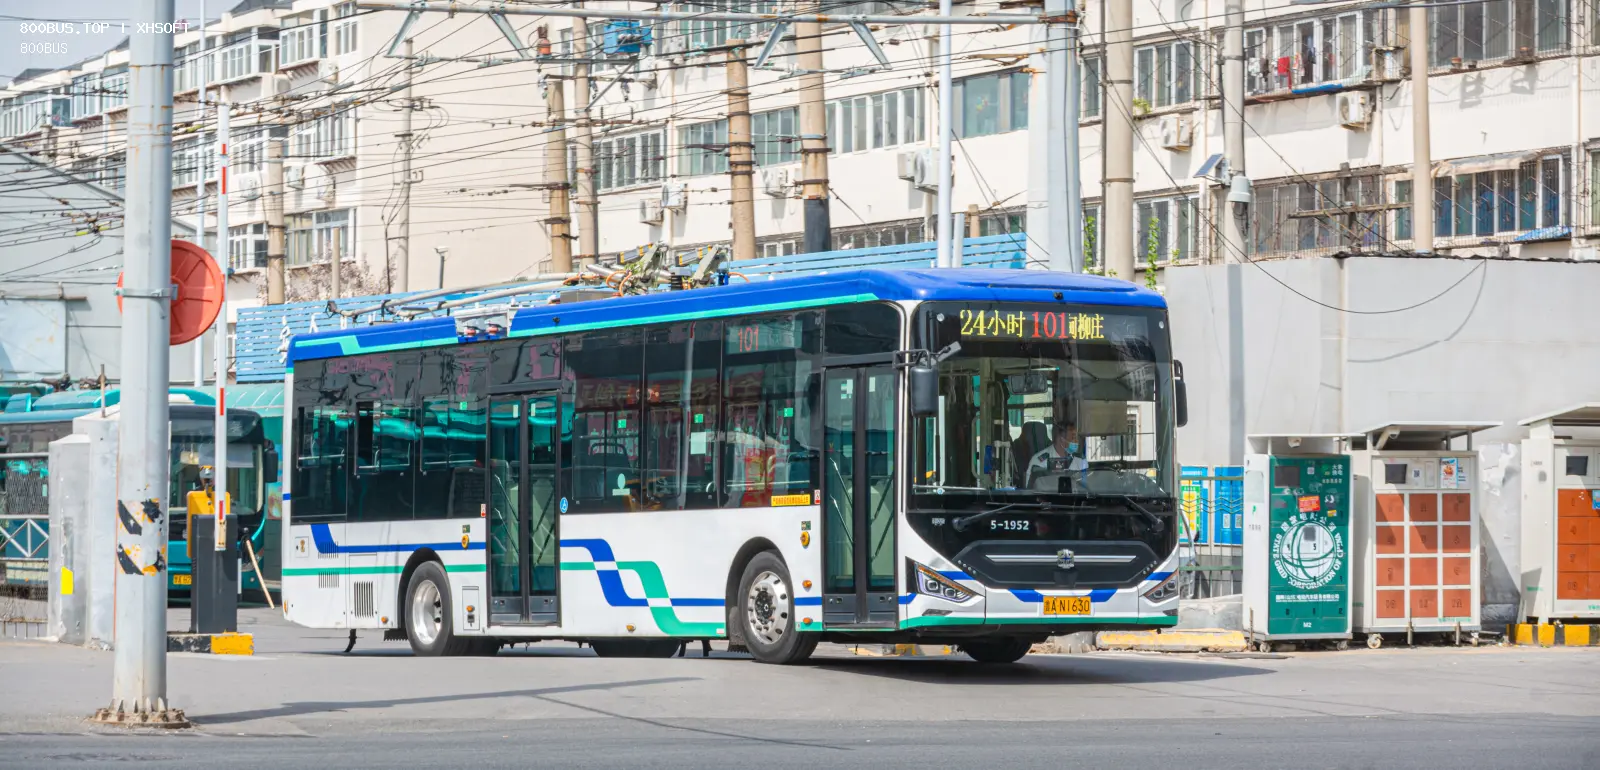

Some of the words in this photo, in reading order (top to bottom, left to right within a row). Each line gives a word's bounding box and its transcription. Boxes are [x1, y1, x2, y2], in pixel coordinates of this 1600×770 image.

[960, 309, 1026, 338] 24小时
[1031, 311, 1069, 339] 101
[738, 325, 759, 352] 101
[990, 519, 1029, 530] 5-1952
